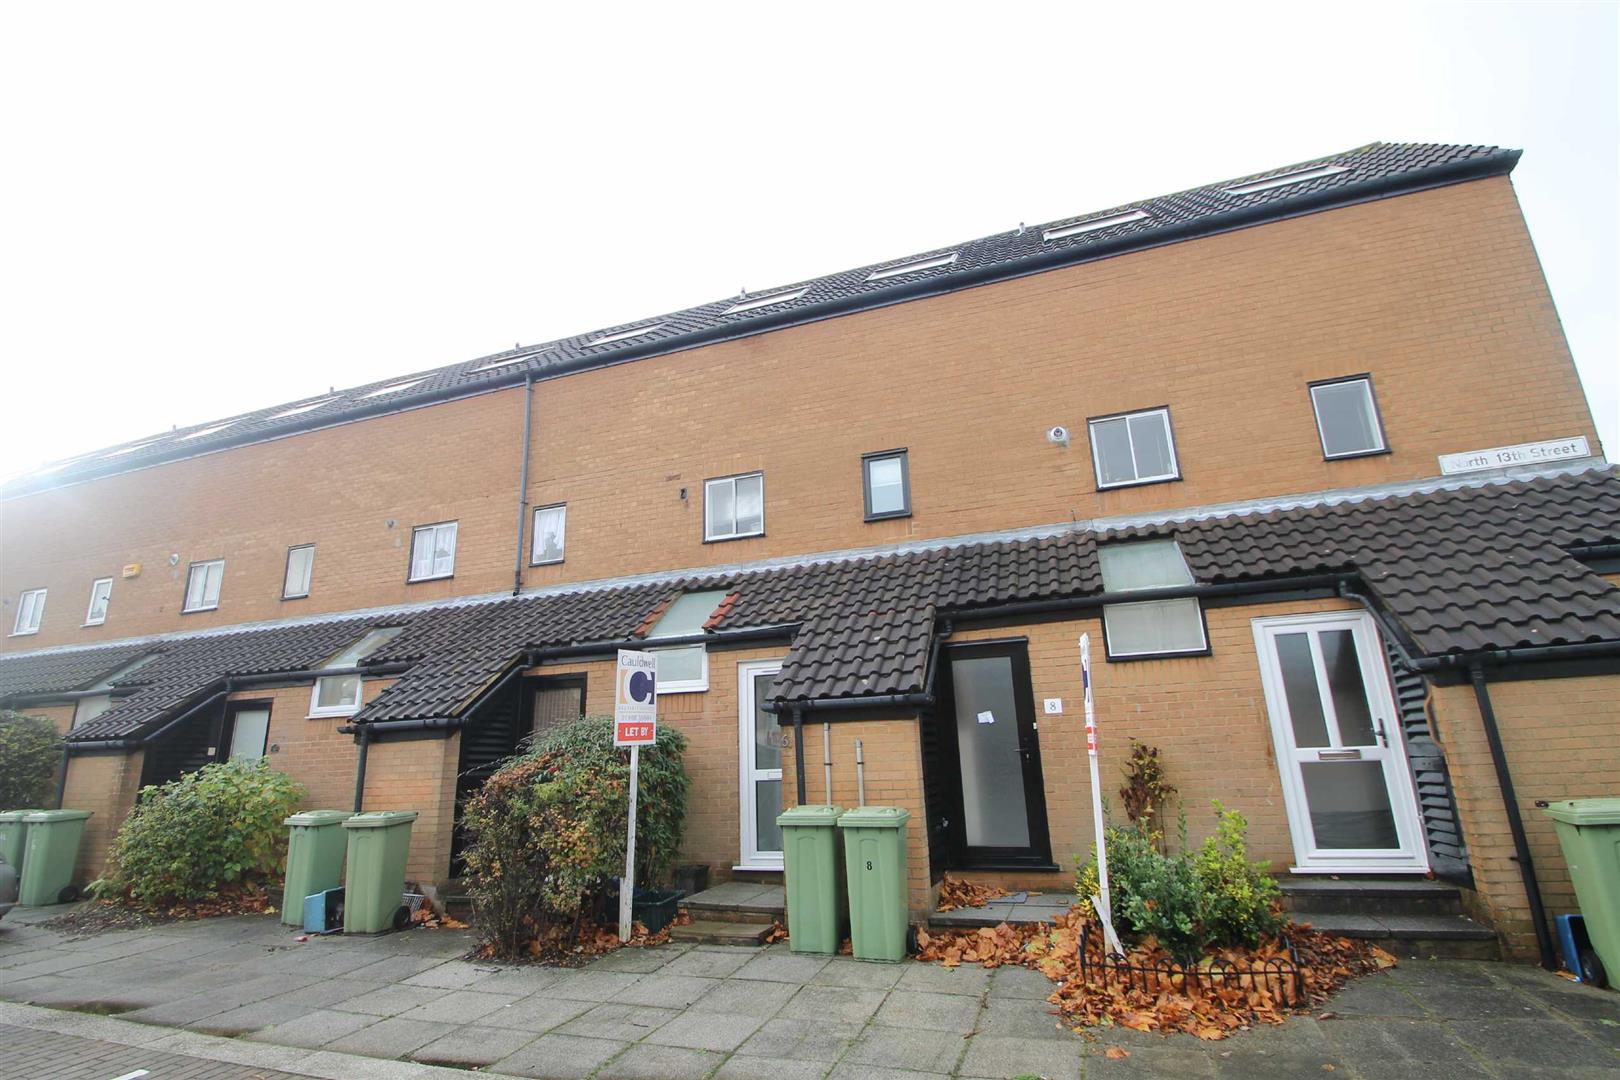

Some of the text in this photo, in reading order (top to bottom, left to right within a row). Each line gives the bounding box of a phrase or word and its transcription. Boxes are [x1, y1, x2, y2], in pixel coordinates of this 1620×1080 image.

[1496, 451, 1526, 463] 13th
[1530, 442, 1577, 458] Street
[621, 655, 656, 668] Cauldwell
[1050, 701, 1056, 711] 8
[625, 727, 649, 737] LET BY
[866, 860, 873, 871] 8
